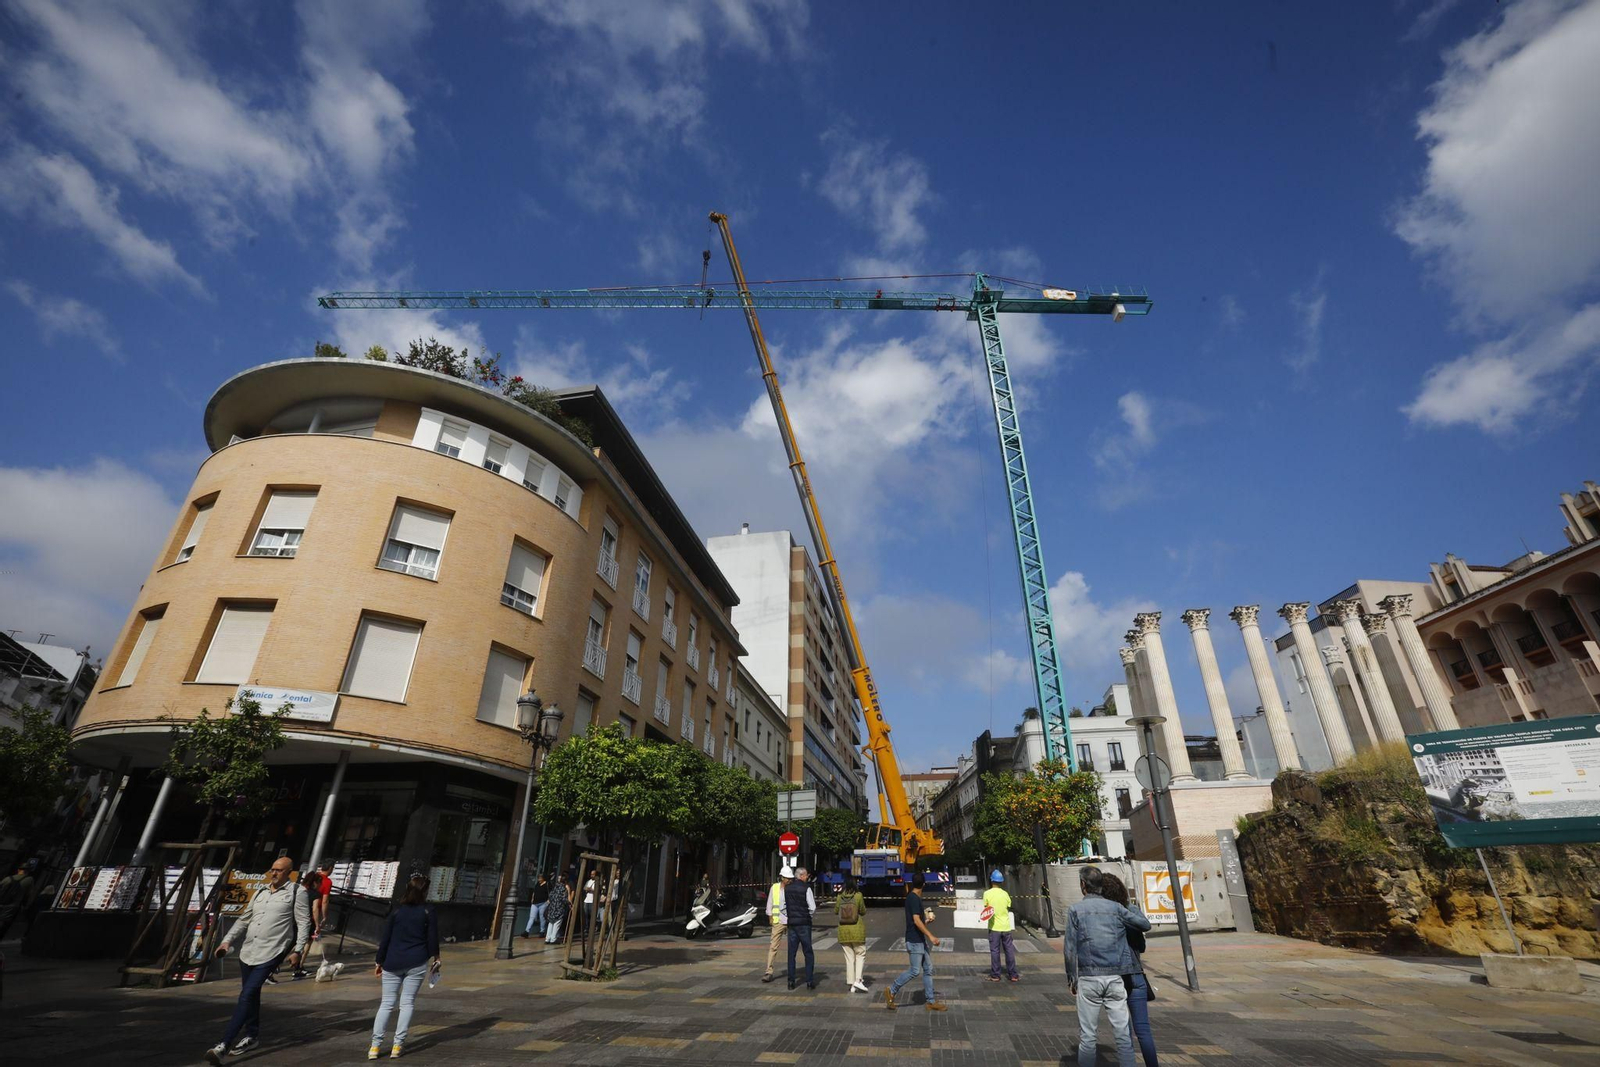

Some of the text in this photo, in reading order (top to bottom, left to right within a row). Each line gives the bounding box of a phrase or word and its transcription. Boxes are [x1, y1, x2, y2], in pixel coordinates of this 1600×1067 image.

[863, 674, 883, 722] MOLERO
[232, 869, 267, 880] Servicio
[221, 904, 244, 912] 957
